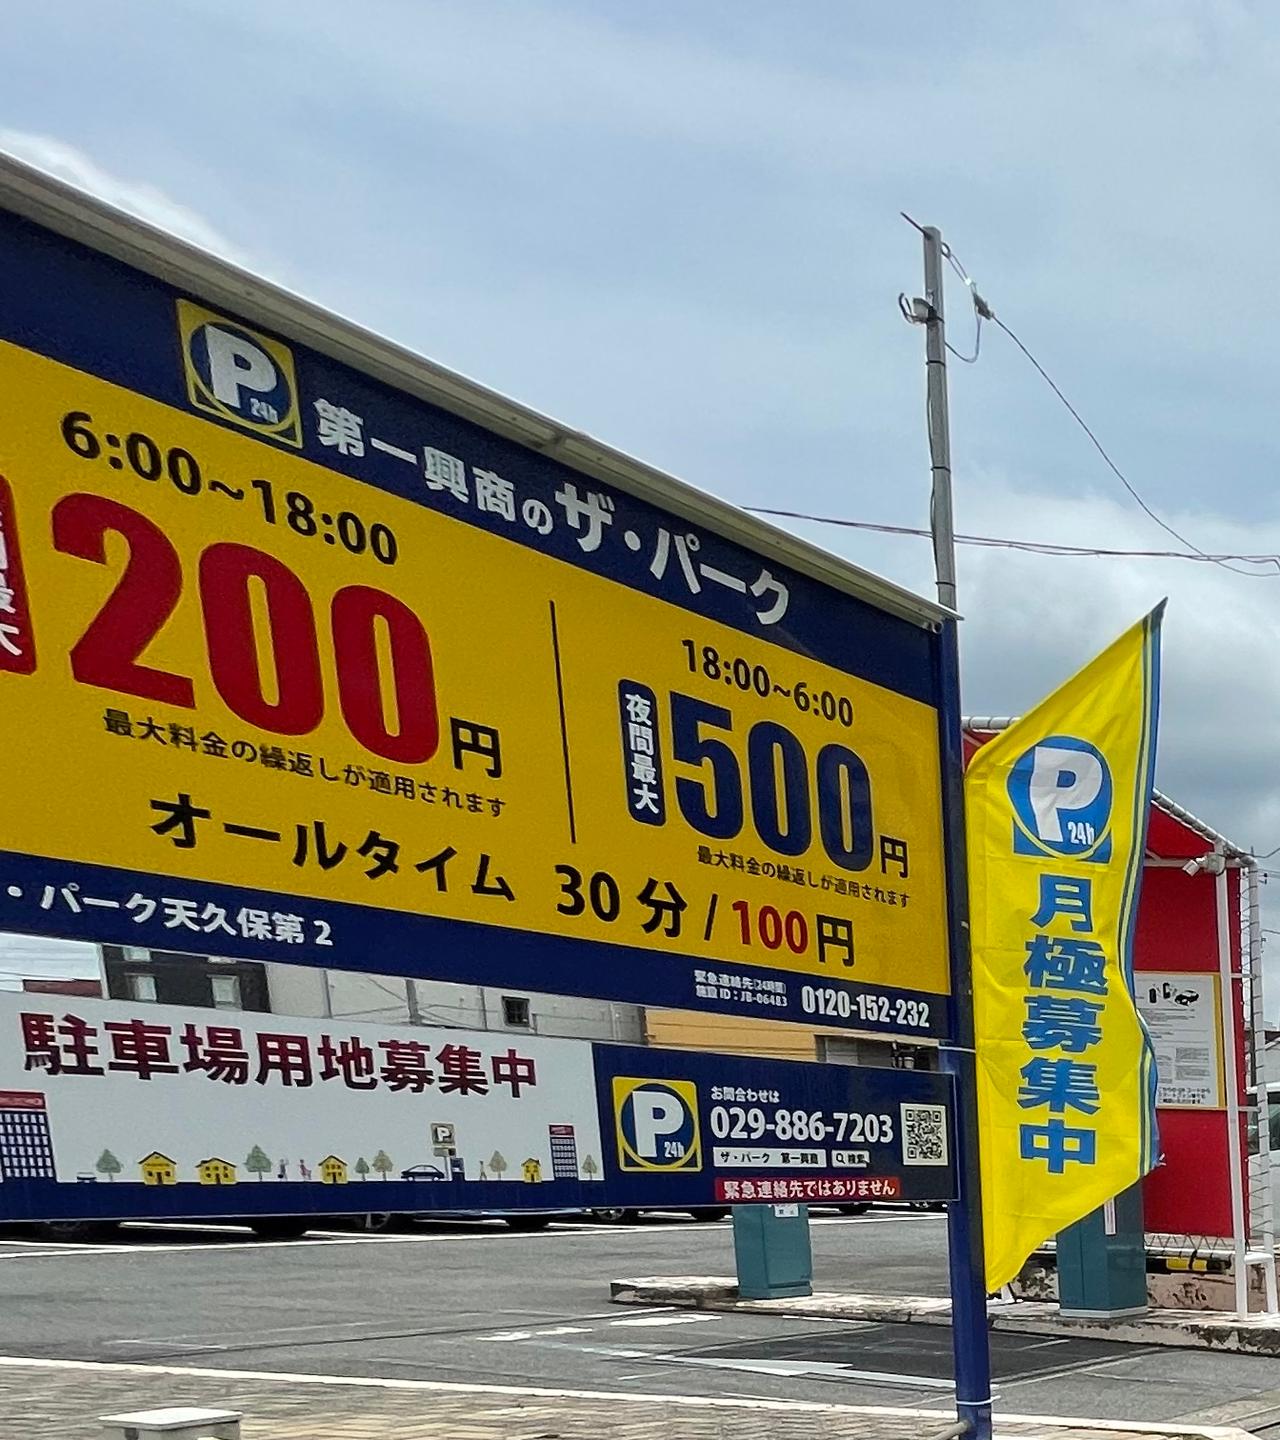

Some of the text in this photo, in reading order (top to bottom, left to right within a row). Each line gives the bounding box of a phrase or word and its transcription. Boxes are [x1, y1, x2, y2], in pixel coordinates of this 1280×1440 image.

[205, 324, 278, 409] P
[103, 708, 506, 818] 最大料金の繰返しが適用されます
[625, 693, 660, 815] 夜間最大
[1028, 745, 1103, 844] P
[149, 793, 516, 901] オールタイム
[1067, 820, 1096, 847] 24h
[697, 843, 911, 908] 最大料金の繰返しが適用されます
[800, 985, 930, 1028] 0120-152-232
[1017, 873, 1109, 1175] 月極募集中
[19, 1011, 537, 1099] 駐車場用地募集中
[632, 1090, 685, 1158] P
[710, 1085, 780, 1103] お問合わせは
[710, 1105, 894, 1144] 029-886-7203
[664, 1141, 685, 1158] 24h
[723, 1177, 896, 1199] 緊急連絡先ではありません
